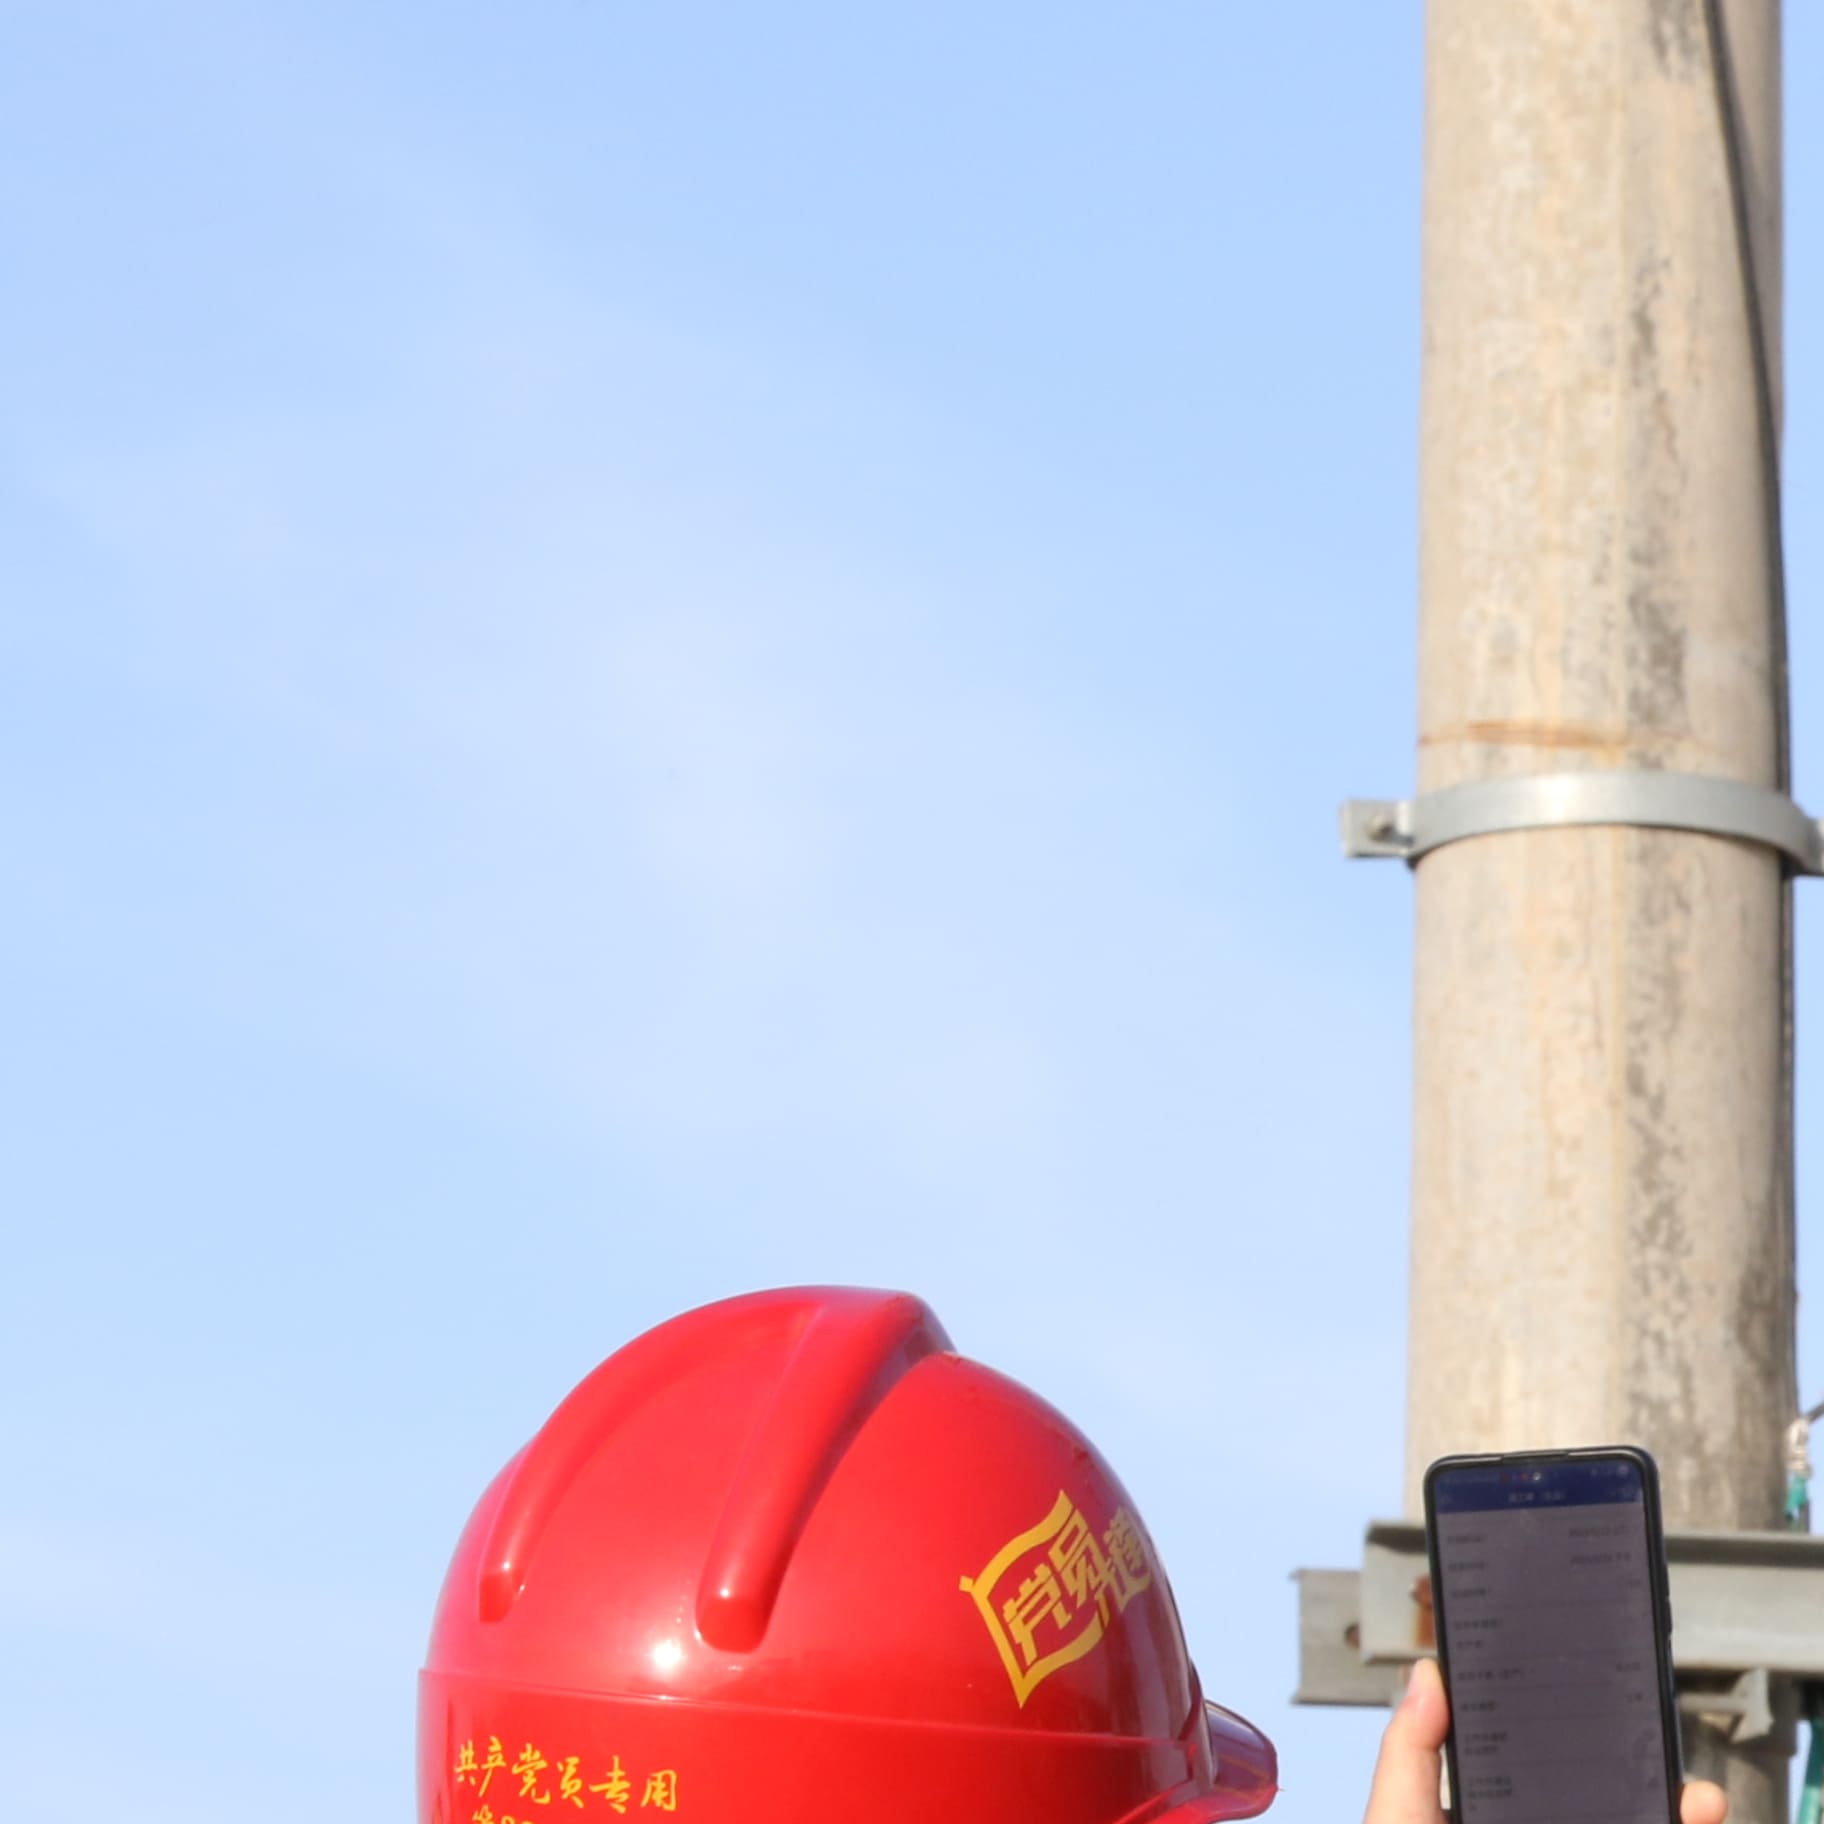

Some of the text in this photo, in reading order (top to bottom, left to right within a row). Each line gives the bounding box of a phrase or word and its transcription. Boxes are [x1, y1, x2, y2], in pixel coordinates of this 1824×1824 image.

[455, 1735, 677, 1814] 共产党员专用
